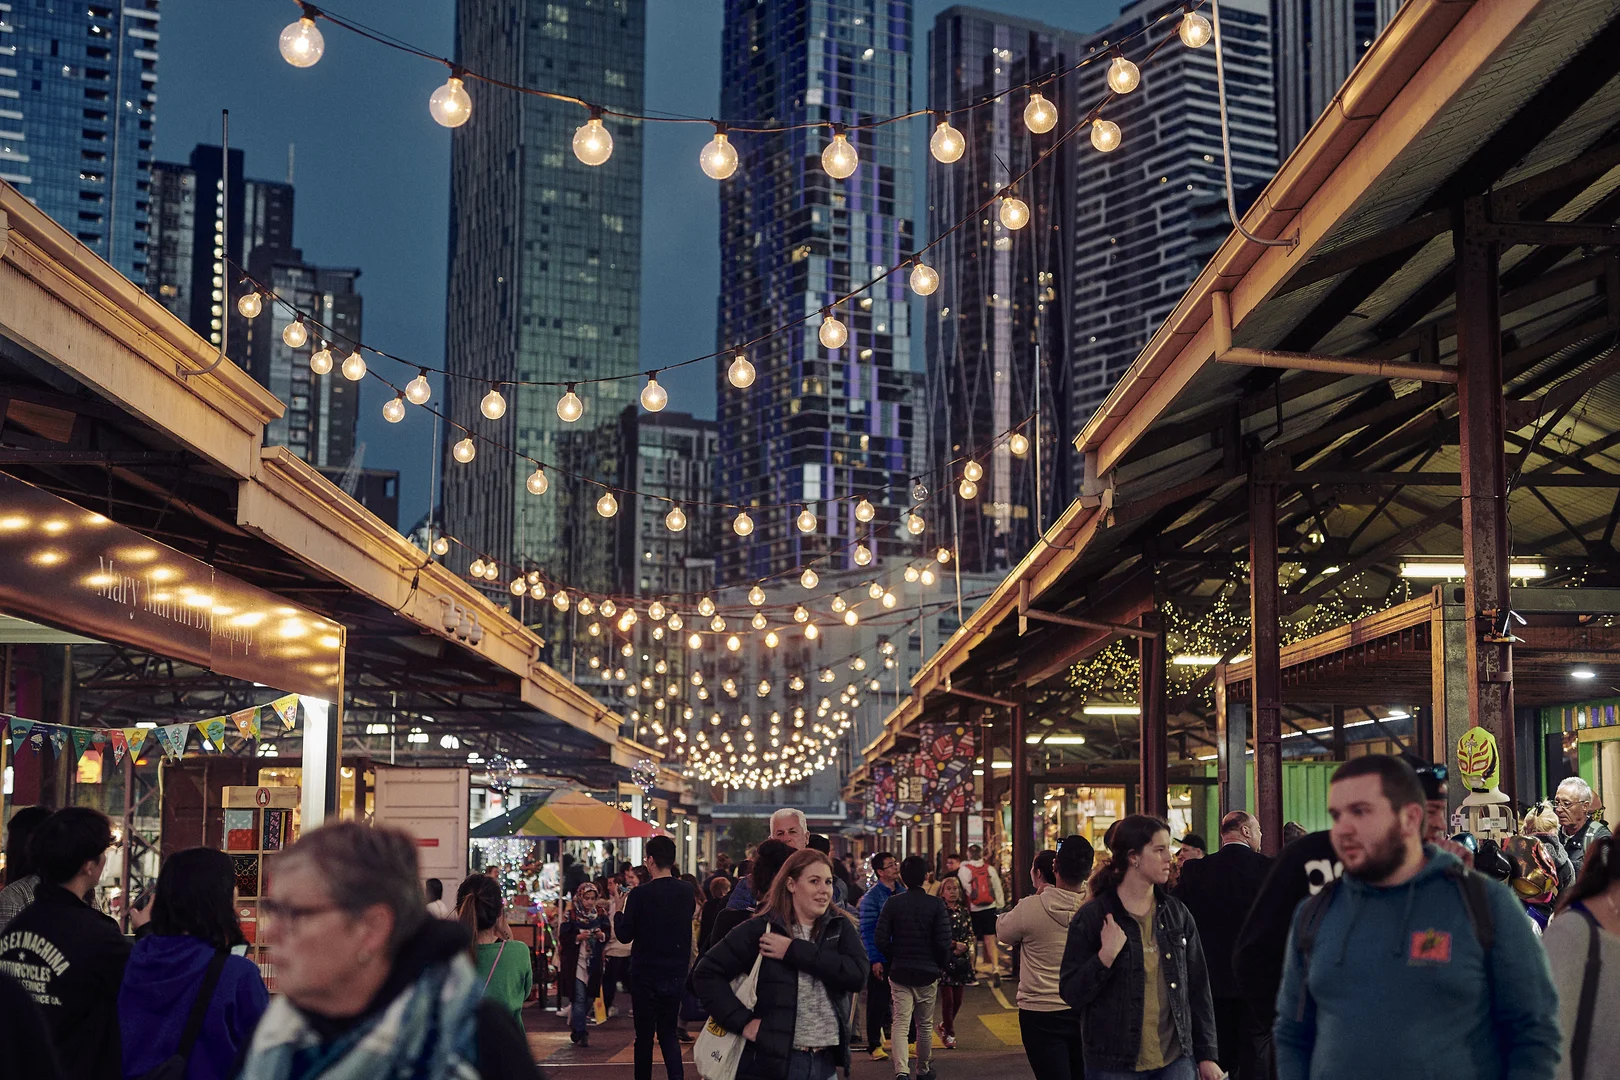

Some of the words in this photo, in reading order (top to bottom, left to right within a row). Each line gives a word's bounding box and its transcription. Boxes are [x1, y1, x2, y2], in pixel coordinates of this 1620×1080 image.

[97, 556, 140, 620] Mary
[144, 575, 192, 626] Martin
[10, 932, 21, 949] EX
[22, 931, 70, 976] MACHINA
